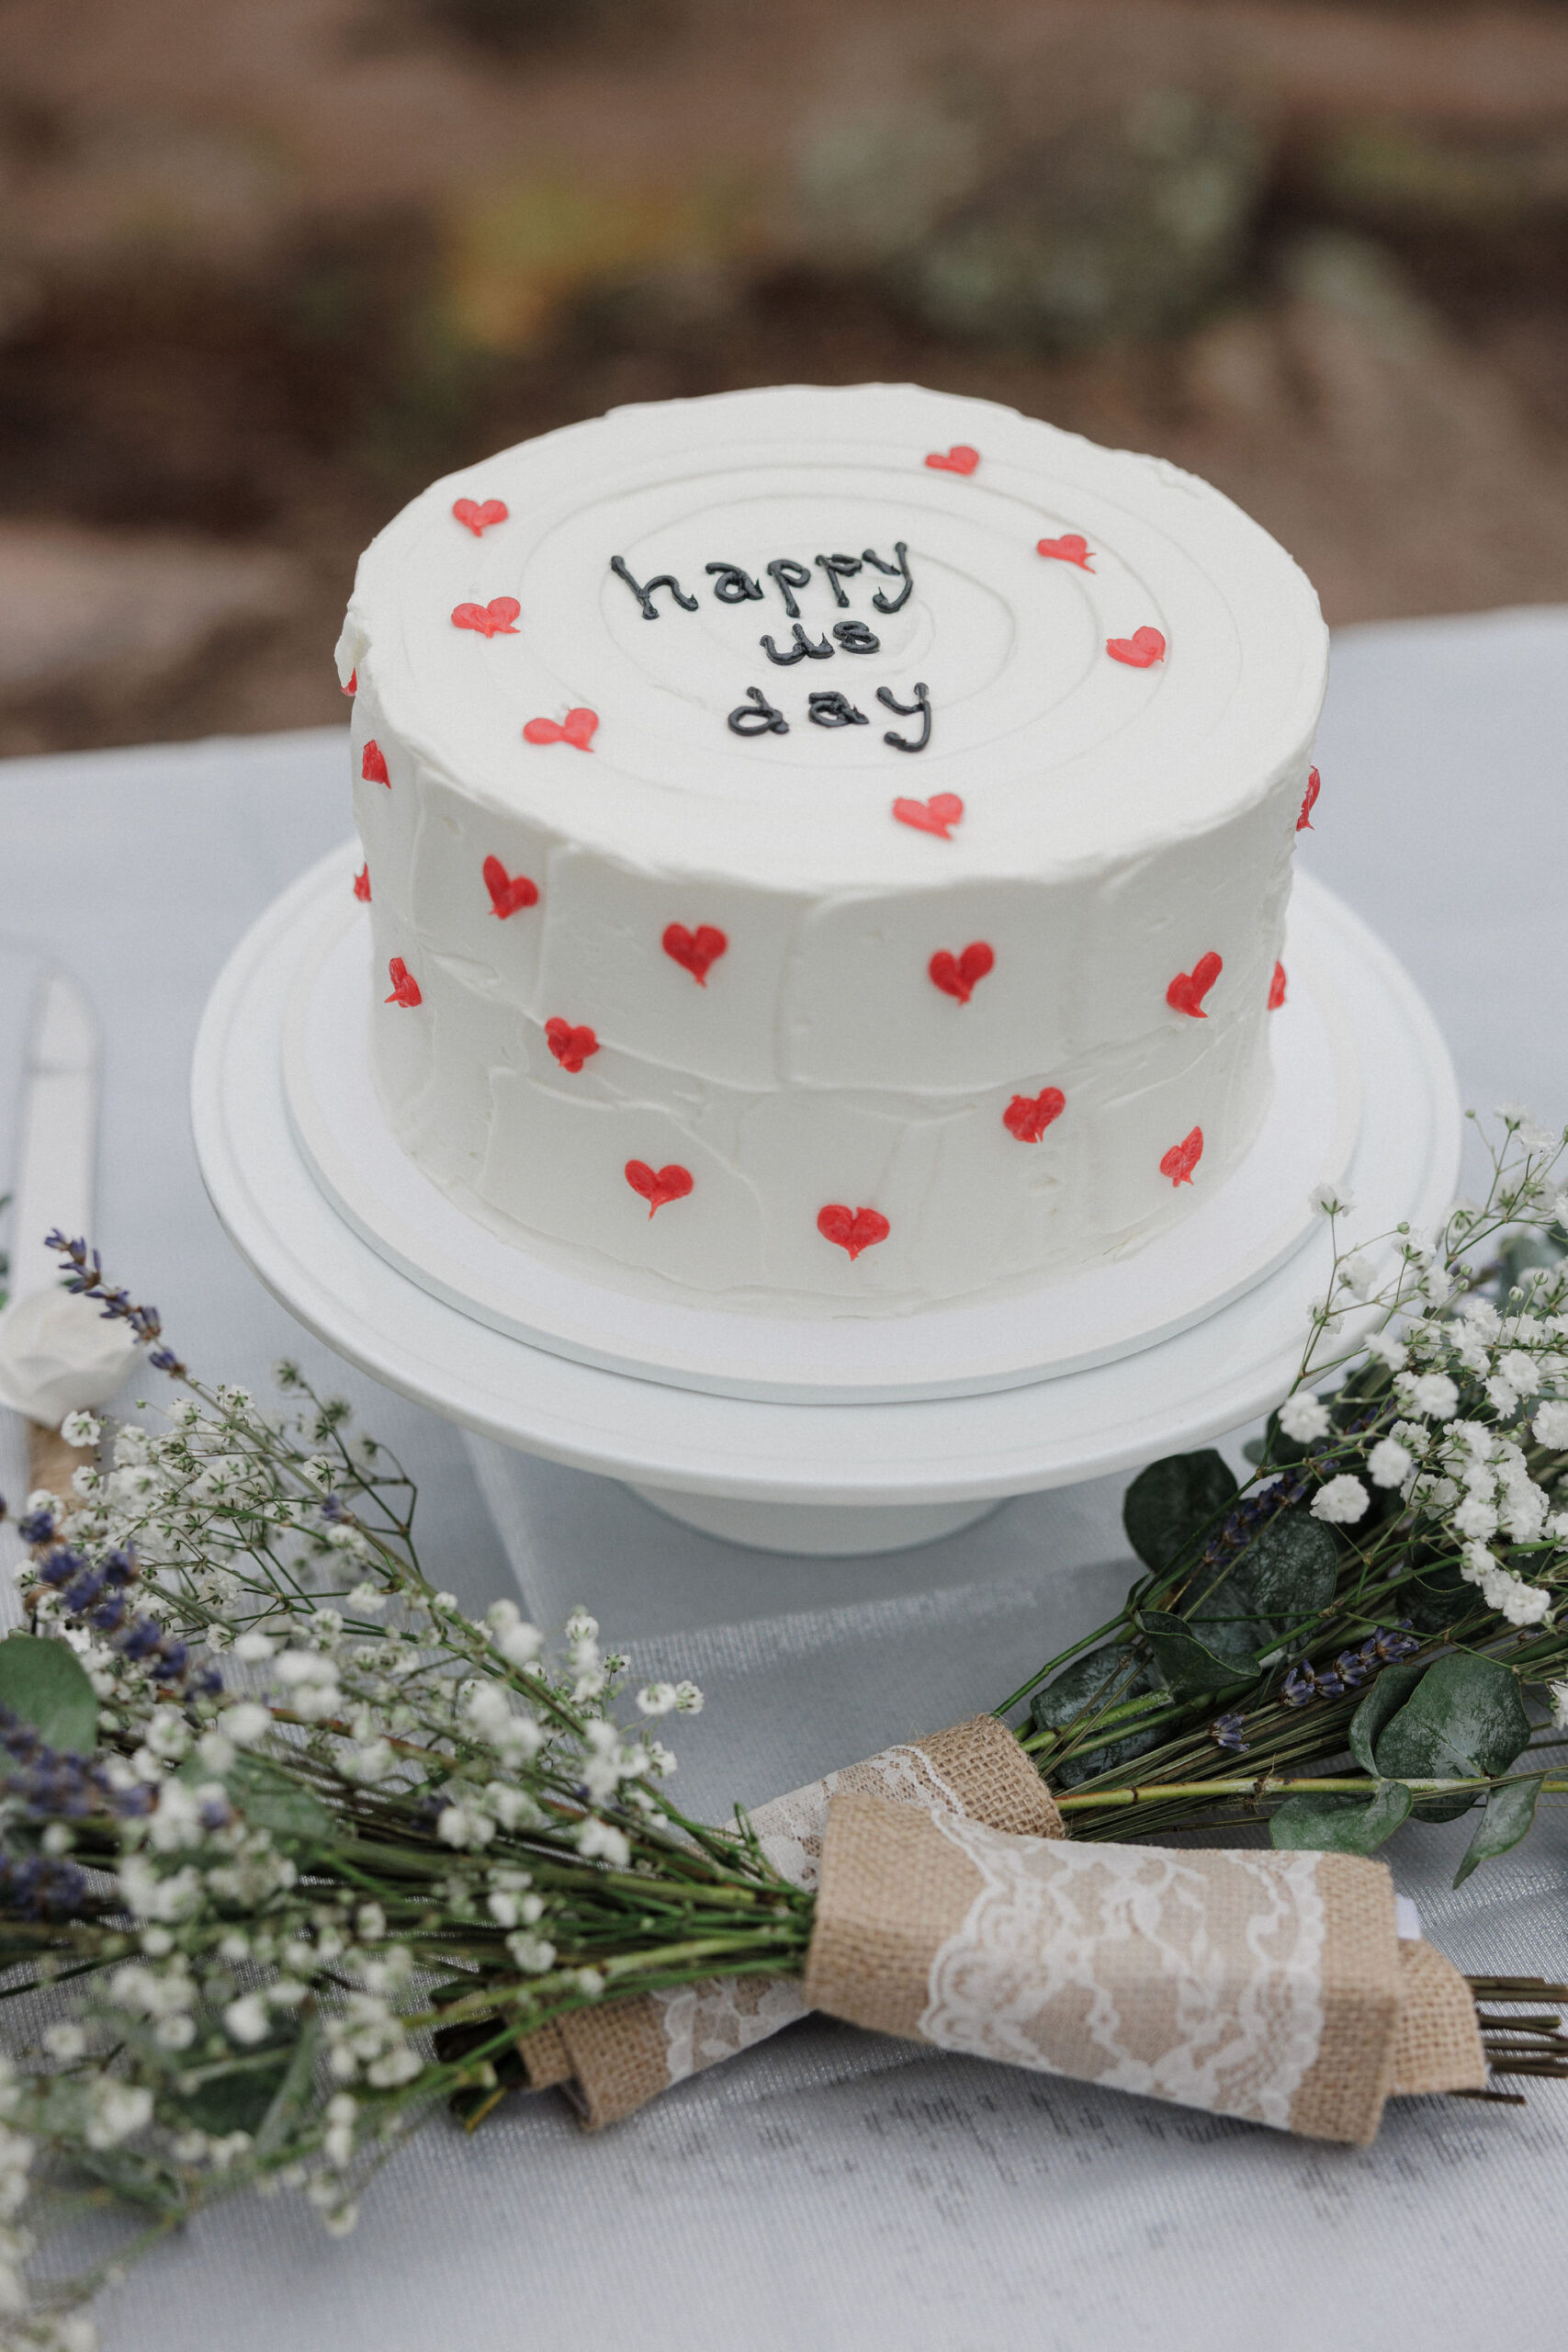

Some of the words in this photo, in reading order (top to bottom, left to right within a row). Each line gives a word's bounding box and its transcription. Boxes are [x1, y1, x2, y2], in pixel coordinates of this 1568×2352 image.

[610, 541, 914, 620] happy
[759, 621, 881, 667] us
[728, 682, 931, 753] day
